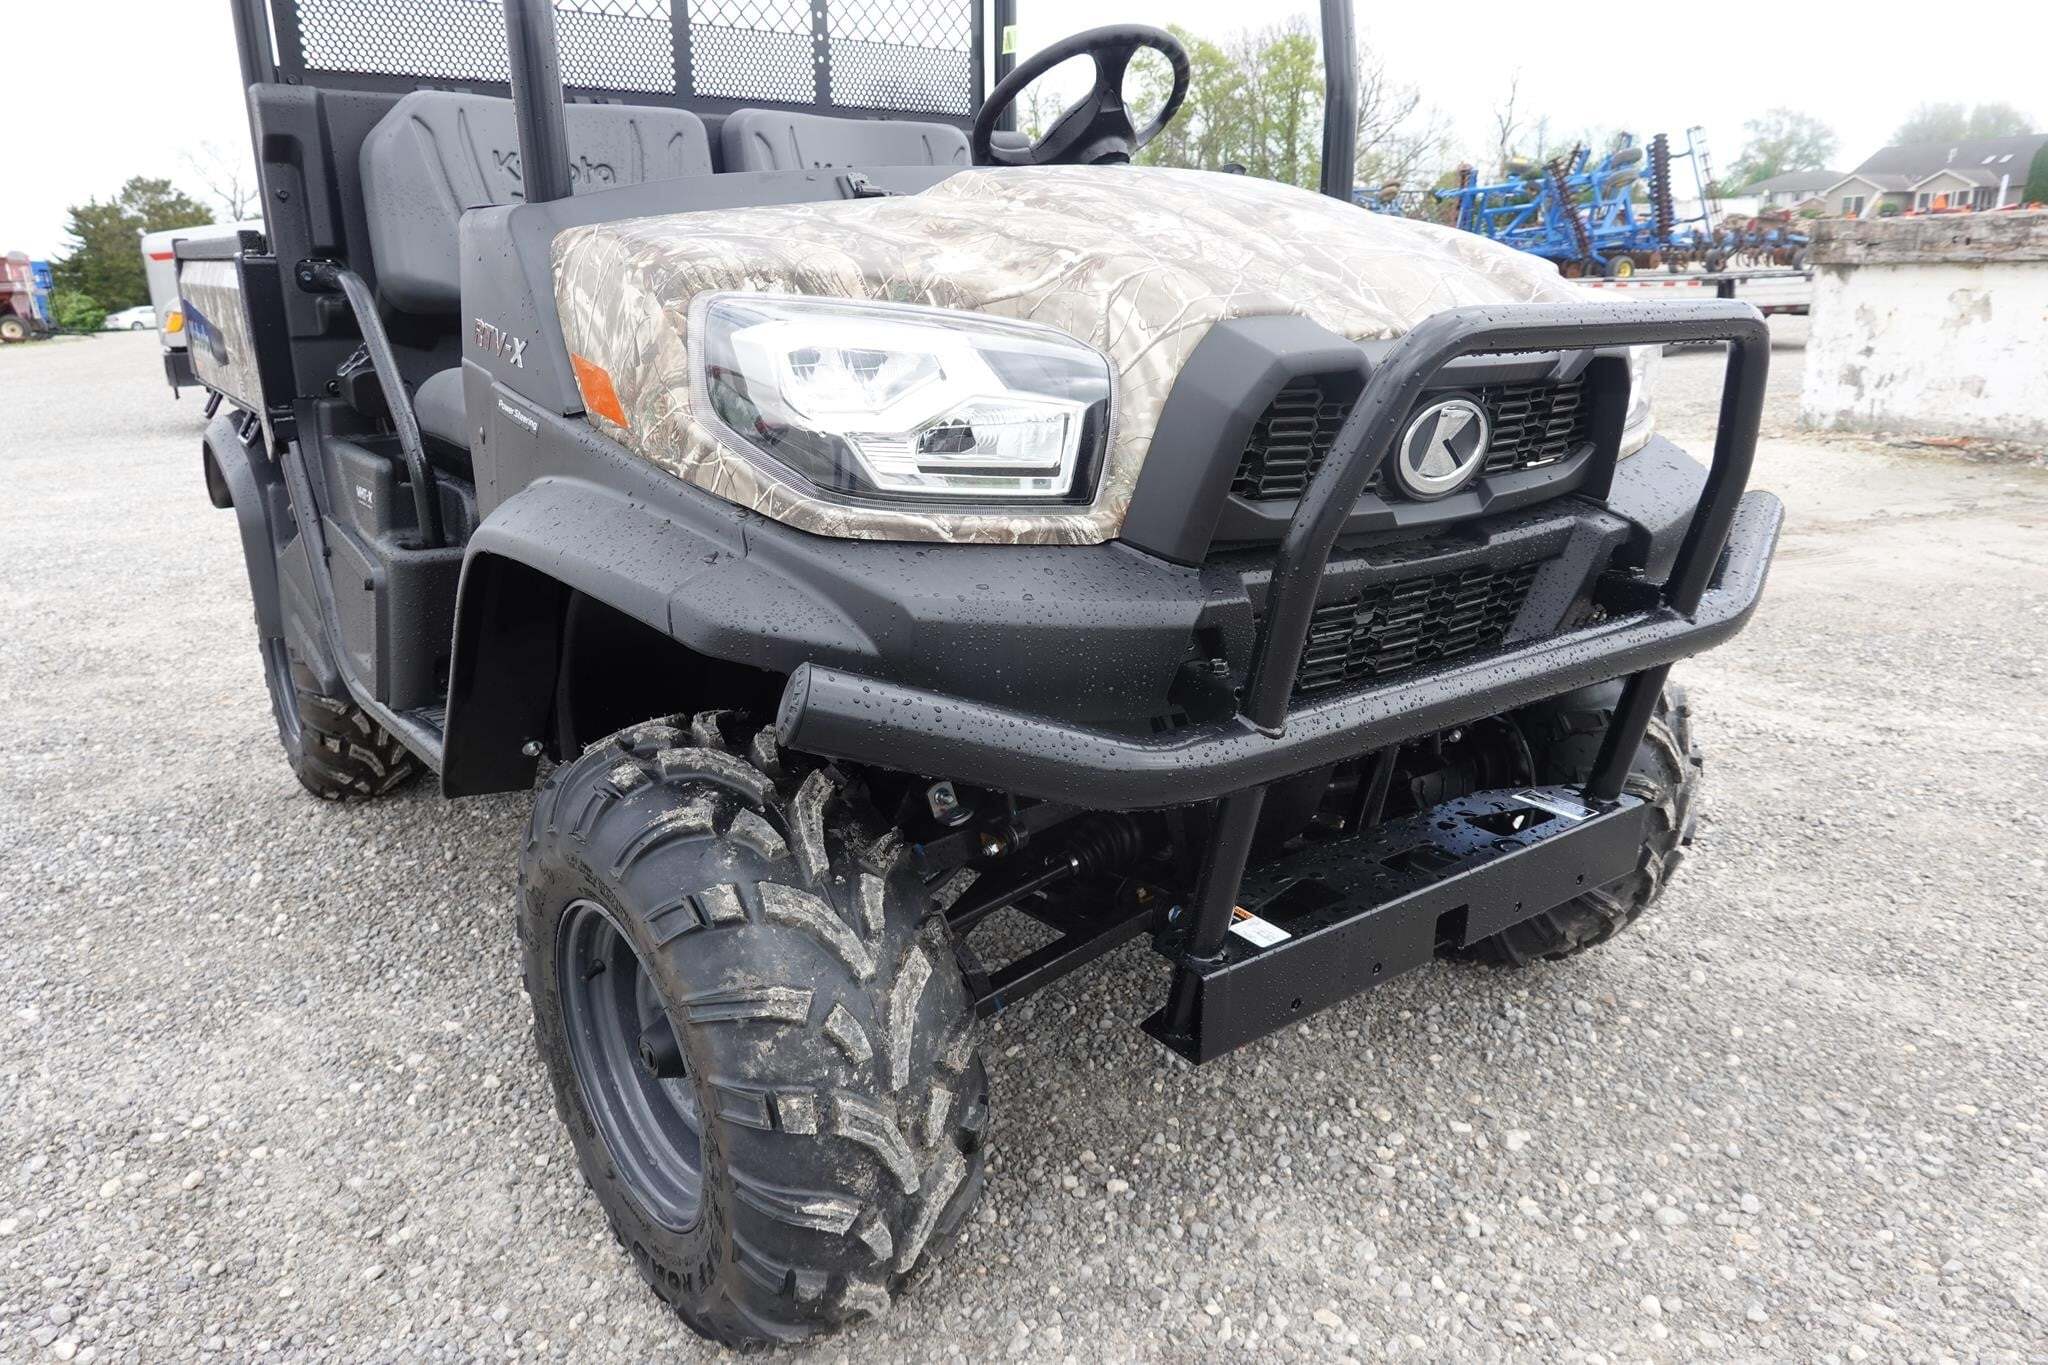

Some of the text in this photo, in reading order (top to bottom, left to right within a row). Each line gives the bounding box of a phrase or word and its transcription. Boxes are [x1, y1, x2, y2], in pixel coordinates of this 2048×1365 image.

[492, 149, 616, 184] Kota
[474, 317, 527, 369] RTV-X
[498, 399, 538, 431] Power Steering
